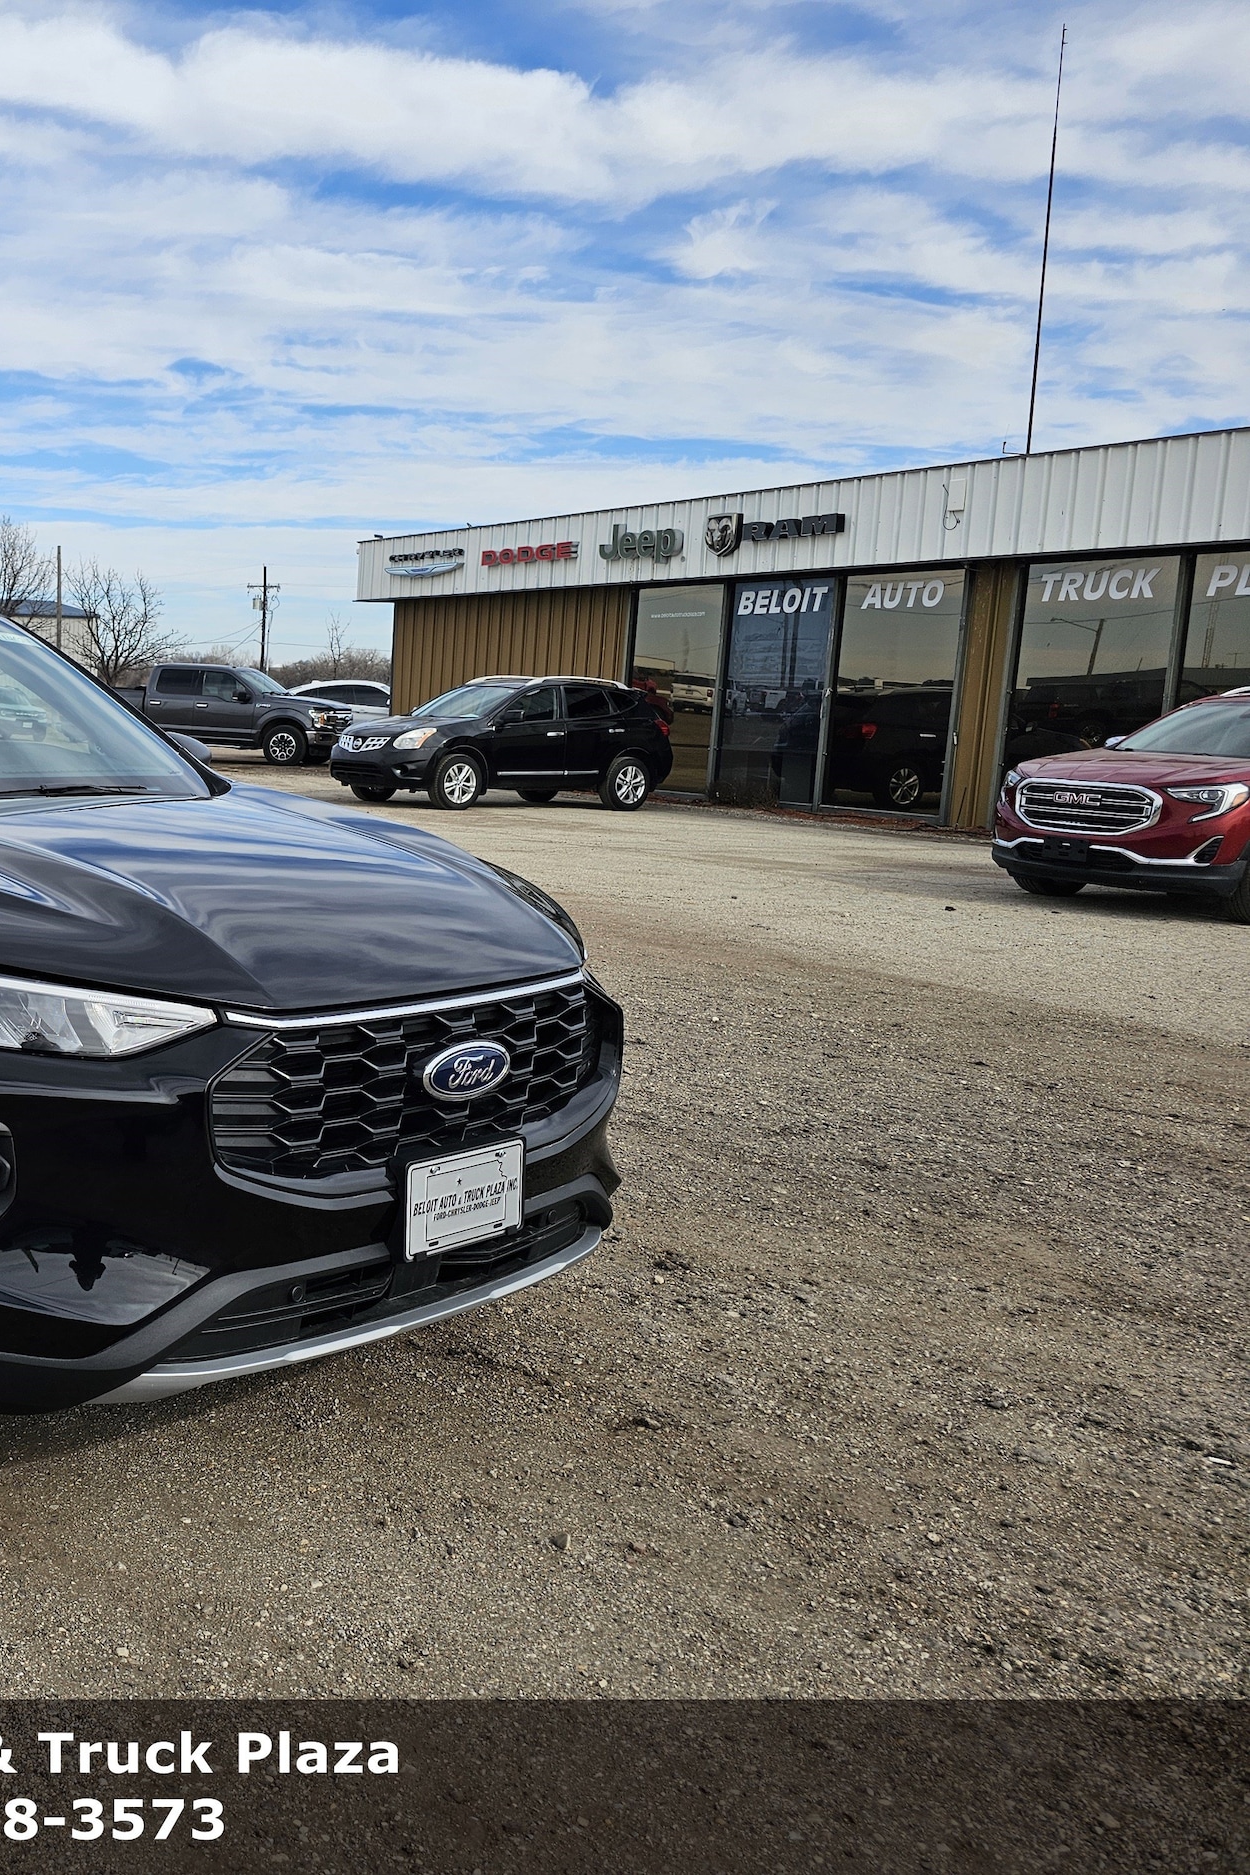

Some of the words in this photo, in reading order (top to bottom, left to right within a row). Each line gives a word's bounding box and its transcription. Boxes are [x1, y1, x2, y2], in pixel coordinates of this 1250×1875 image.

[599, 523, 683, 564] Jeep
[742, 512, 845, 541] RAM
[481, 541, 579, 567] DODGE
[737, 586, 829, 616] BELOIT
[860, 579, 945, 610] AUTO
[1041, 567, 1163, 602] TRUCK
[1053, 791, 1102, 807] GMC
[448, 1054, 496, 1089] Ford
[413, 1198, 439, 1217] BELOIT
[438, 1193, 457, 1211] AUTO
[463, 1186, 485, 1204] TRUCK
[485, 1180, 506, 1198] PLAZA
[506, 1177, 519, 1193] INC.
